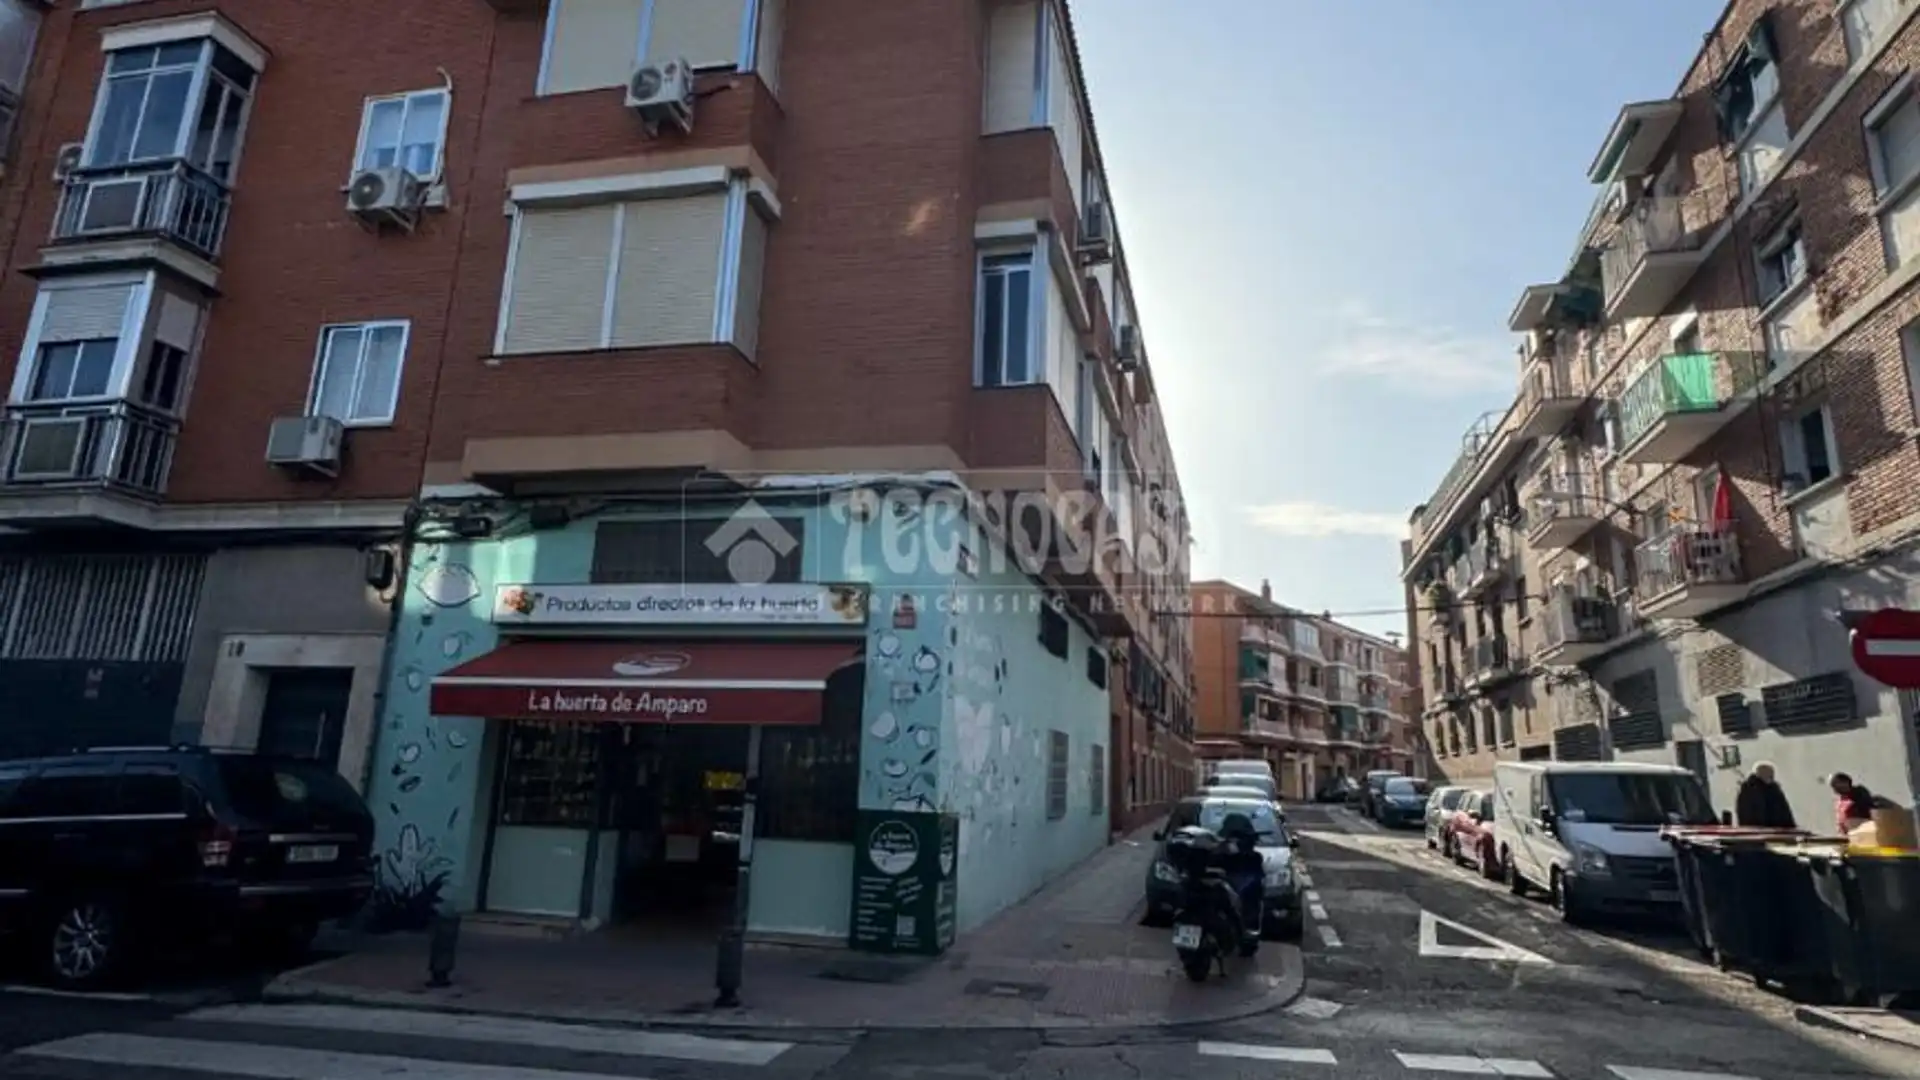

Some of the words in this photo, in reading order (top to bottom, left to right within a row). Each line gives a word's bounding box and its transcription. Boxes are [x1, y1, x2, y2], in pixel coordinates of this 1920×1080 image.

[546, 594, 632, 612] Productos
[637, 594, 705, 612] directos
[711, 595, 733, 611] de
[739, 595, 756, 611] la
[759, 595, 819, 612] huerta
[528, 690, 550, 710] La
[554, 691, 608, 712] huerta
[611, 692, 632, 712] de
[636, 692, 707, 718] Amparo
